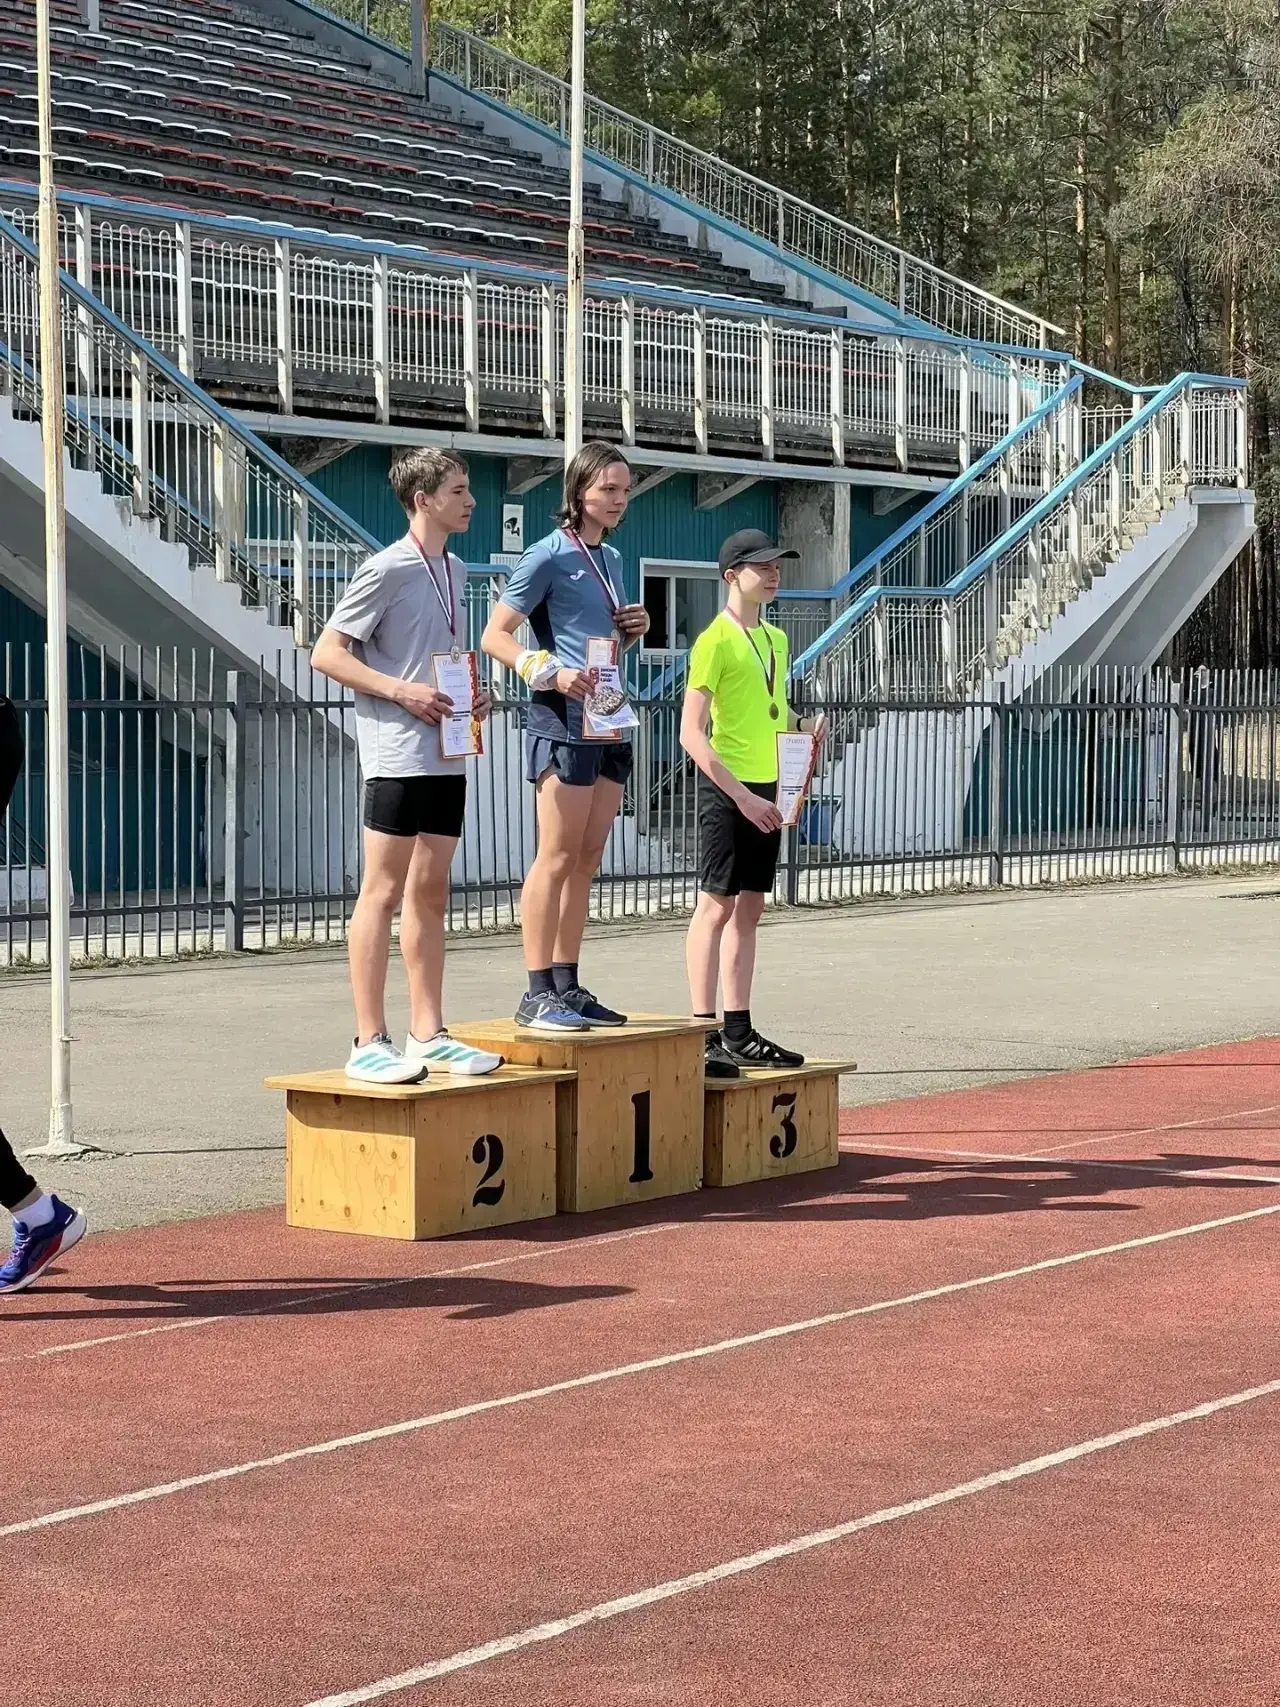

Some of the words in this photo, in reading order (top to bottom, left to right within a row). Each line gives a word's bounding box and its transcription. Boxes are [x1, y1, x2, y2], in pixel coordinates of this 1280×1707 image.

[629, 1090, 654, 1183] 1
[769, 1092, 798, 1159] 3
[472, 1133, 506, 1208] 2
